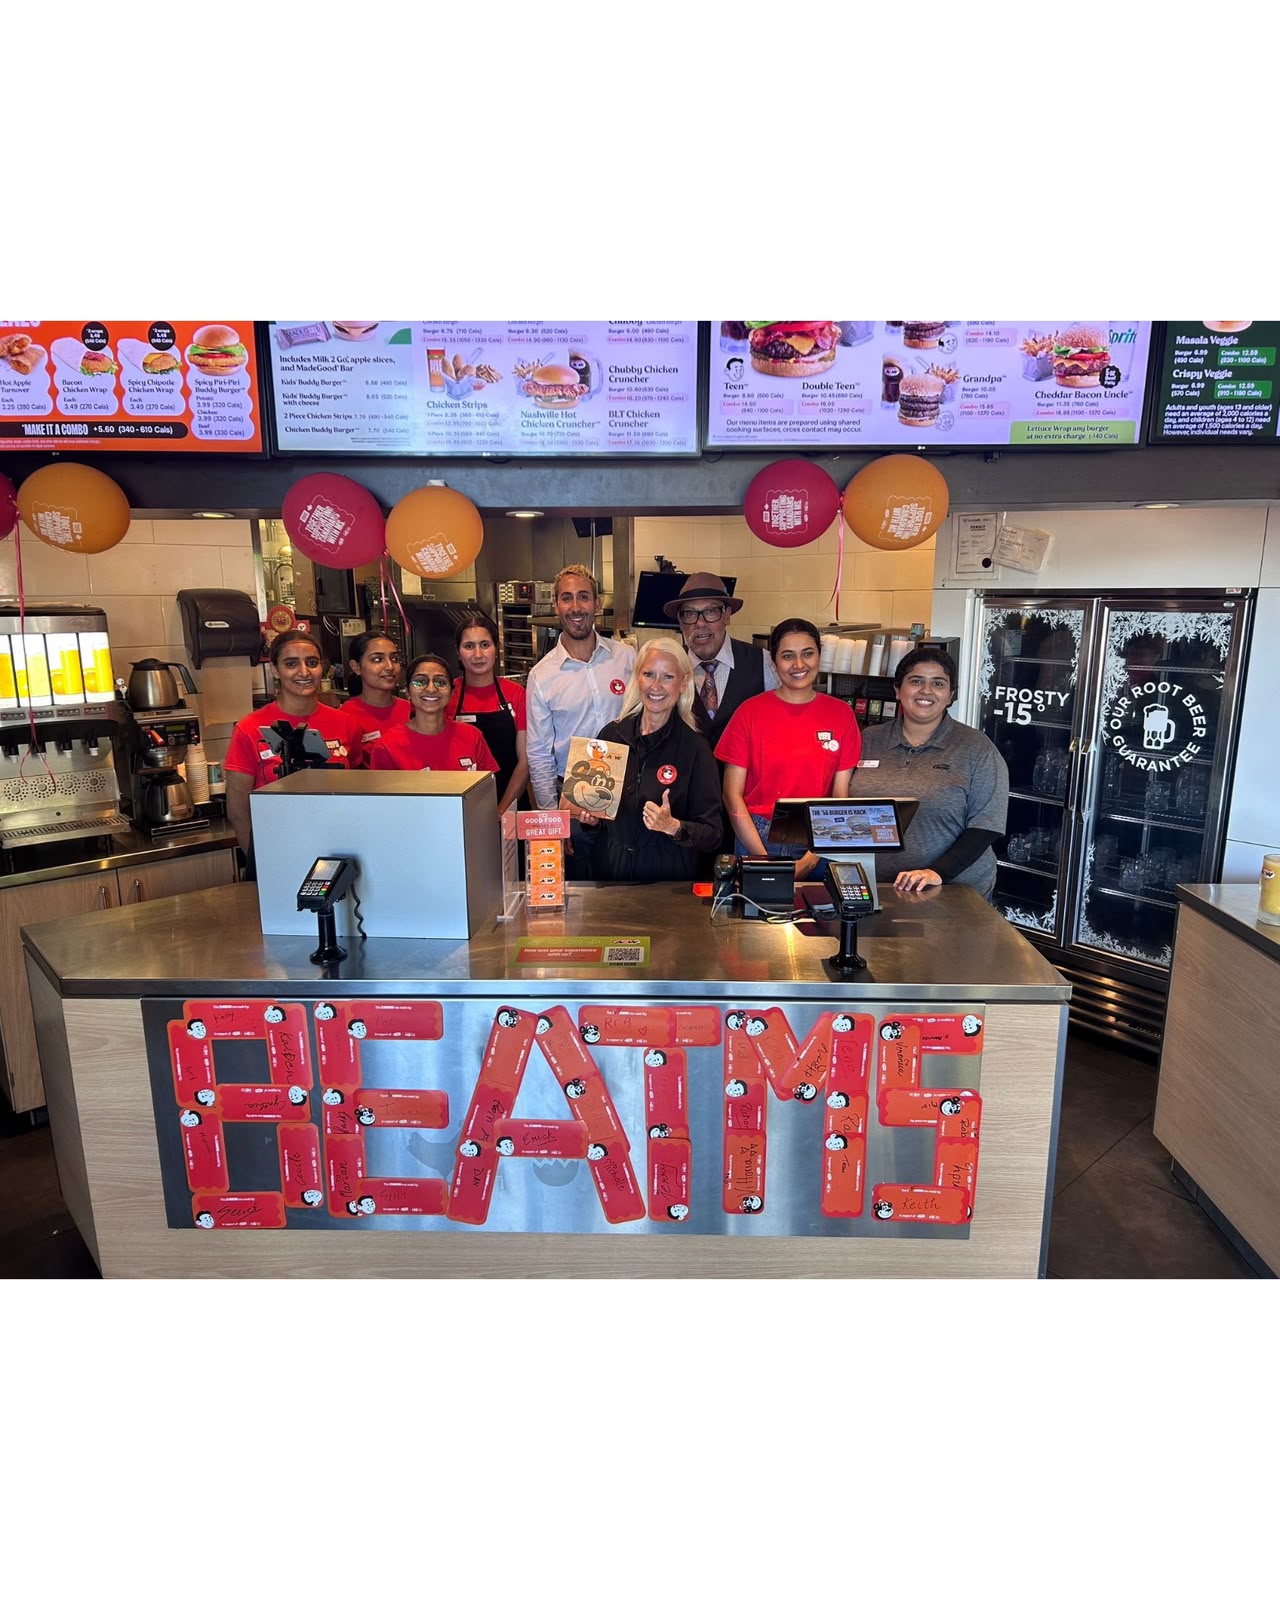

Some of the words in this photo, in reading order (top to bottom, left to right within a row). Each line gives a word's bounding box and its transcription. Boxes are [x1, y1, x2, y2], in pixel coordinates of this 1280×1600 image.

[1175, 335, 1208, 345] Masala
[1210, 335, 1239, 346] Veggie
[280, 355, 311, 363] Includes
[312, 355, 329, 363] Milk
[331, 355, 335, 363] 2
[350, 356, 371, 365] apple
[372, 355, 396, 363] slices,
[280, 364, 295, 372] and
[340, 364, 354, 372] Bar
[608, 365, 643, 375] Chubby
[644, 365, 679, 374] Chicken
[608, 375, 649, 383] Cruncher
[1172, 369, 1203, 380] Crispy
[1204, 369, 1233, 380] Veggie
[13, 379, 31, 387] Apple
[128, 379, 147, 387] Spicy
[147, 379, 175, 387] Chipotle
[195, 379, 213, 387] Spicy
[802, 382, 833, 390] Double
[195, 386, 218, 394] Buddy
[1034, 390, 1072, 399] Cheddar
[1074, 390, 1102, 399] Bacon
[426, 400, 460, 409] Chicken
[461, 400, 488, 410] Strips
[1198, 404, 1216, 412] youth
[1217, 404, 1234, 412] (ages
[520, 410, 559, 419] Nashville
[561, 410, 577, 419] Hot
[608, 410, 625, 418] BLT
[626, 410, 660, 418] Chicken
[521, 420, 554, 428] Chicken
[608, 420, 649, 428] Cruncher
[789, 419, 818, 427] prepared
[820, 419, 837, 427] using
[46, 424, 54, 435] IT
[55, 424, 60, 435] A
[61, 424, 89, 435] COMBO
[93, 425, 115, 433] +5.60
[118, 425, 134, 435] (340
[726, 426, 751, 434] cooking
[305, 505, 324, 531] TOGETHER
[771, 499, 780, 528] TOGETHER
[779, 495, 787, 531] SUPPORTING
[786, 496, 794, 530] CANADIANS
[793, 509, 802, 526] WITH
[311, 506, 334, 540] SUPPORTING
[319, 513, 340, 543] CANADIANS
[326, 529, 340, 544] WITH
[995, 685, 1070, 707] FROSTY
[1110, 697, 1132, 730] OUR
[1130, 681, 1183, 699] ROOT
[1181, 693, 1207, 738] BEER
[1112, 735, 1201, 773] GUARANTEE
[525, 828, 546, 836] GREAT
[902, 1197, 941, 1210] Keith
